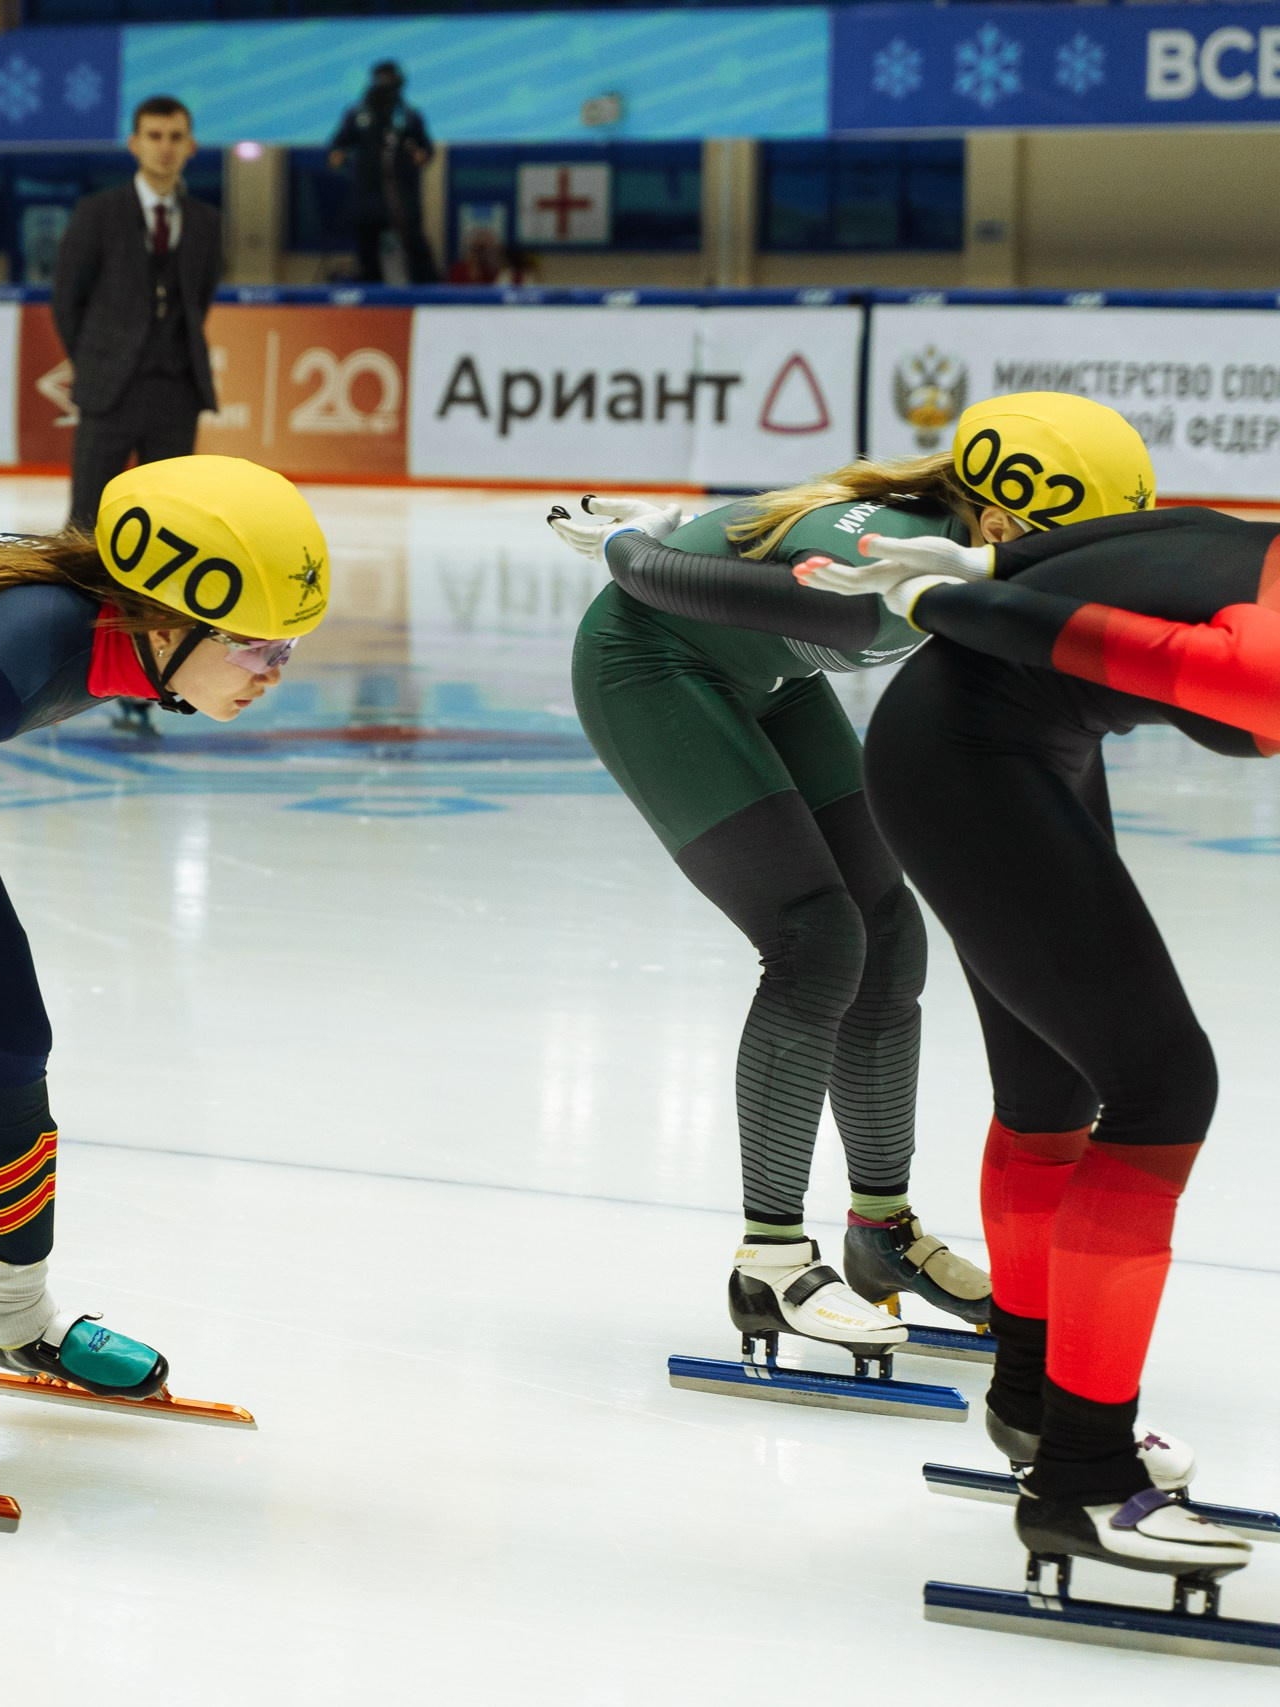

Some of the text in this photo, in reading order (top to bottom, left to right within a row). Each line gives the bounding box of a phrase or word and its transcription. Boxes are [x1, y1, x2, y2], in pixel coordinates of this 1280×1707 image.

[288, 347, 404, 435] 20
[436, 353, 743, 438] Ариант
[991, 358, 1213, 399] МИНИСТЕРСТВО
[962, 428, 1086, 531] 062
[110, 506, 243, 620] 070
